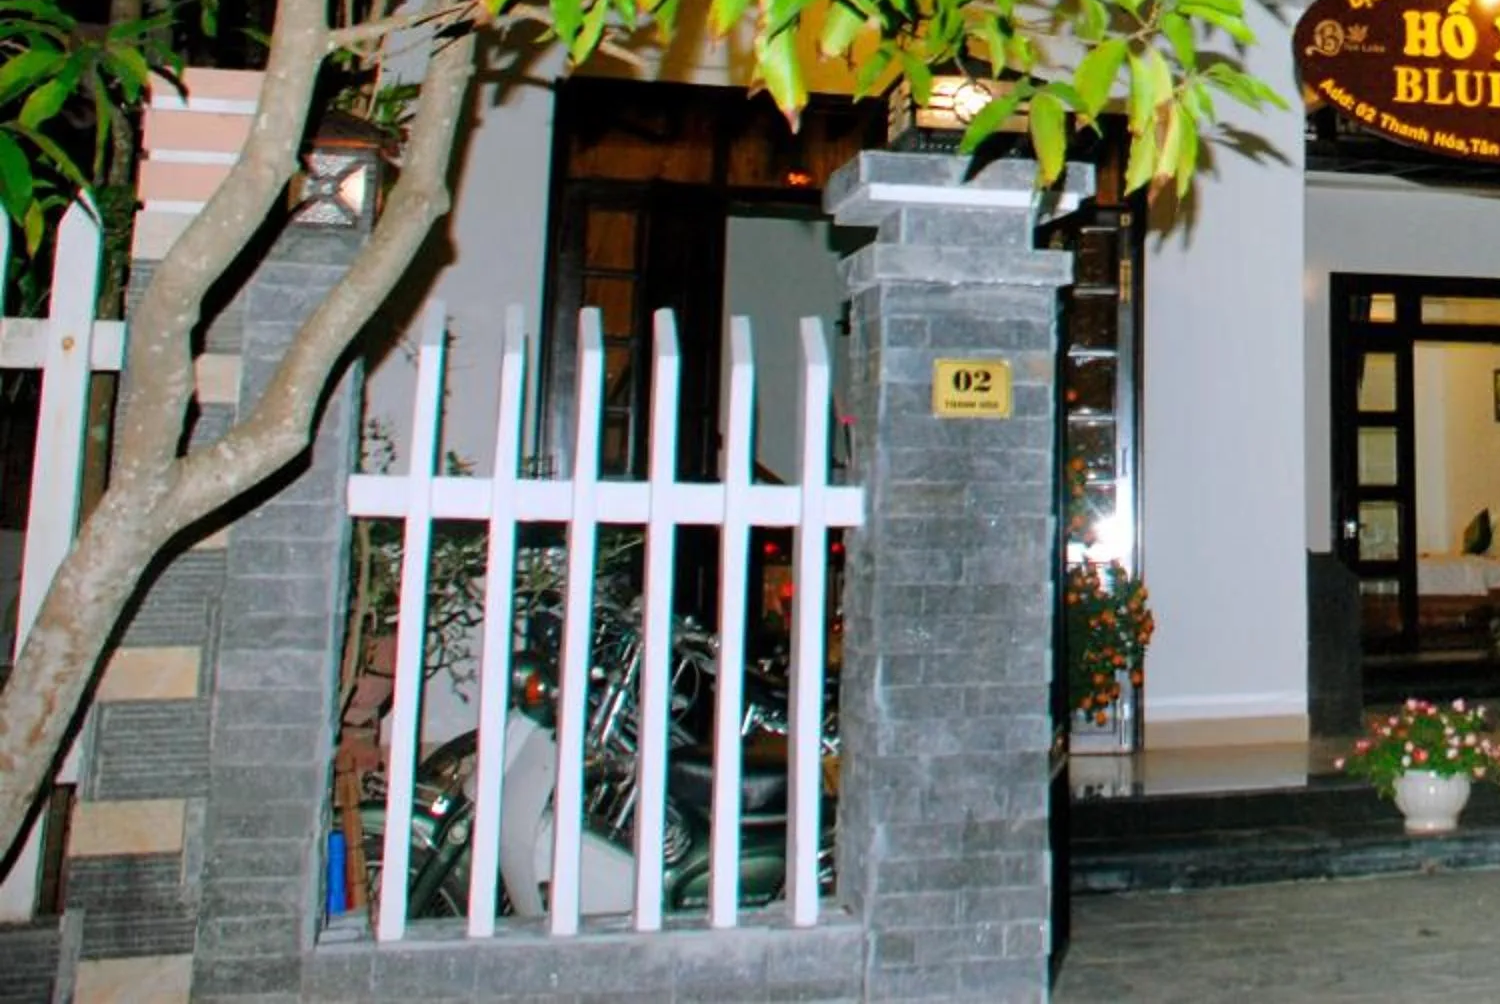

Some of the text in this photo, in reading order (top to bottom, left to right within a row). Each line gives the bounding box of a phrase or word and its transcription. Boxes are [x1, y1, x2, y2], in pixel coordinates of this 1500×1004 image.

[1355, 102, 1377, 123] 02
[1381, 111, 1430, 143] Thanh
[953, 368, 992, 392] 02
